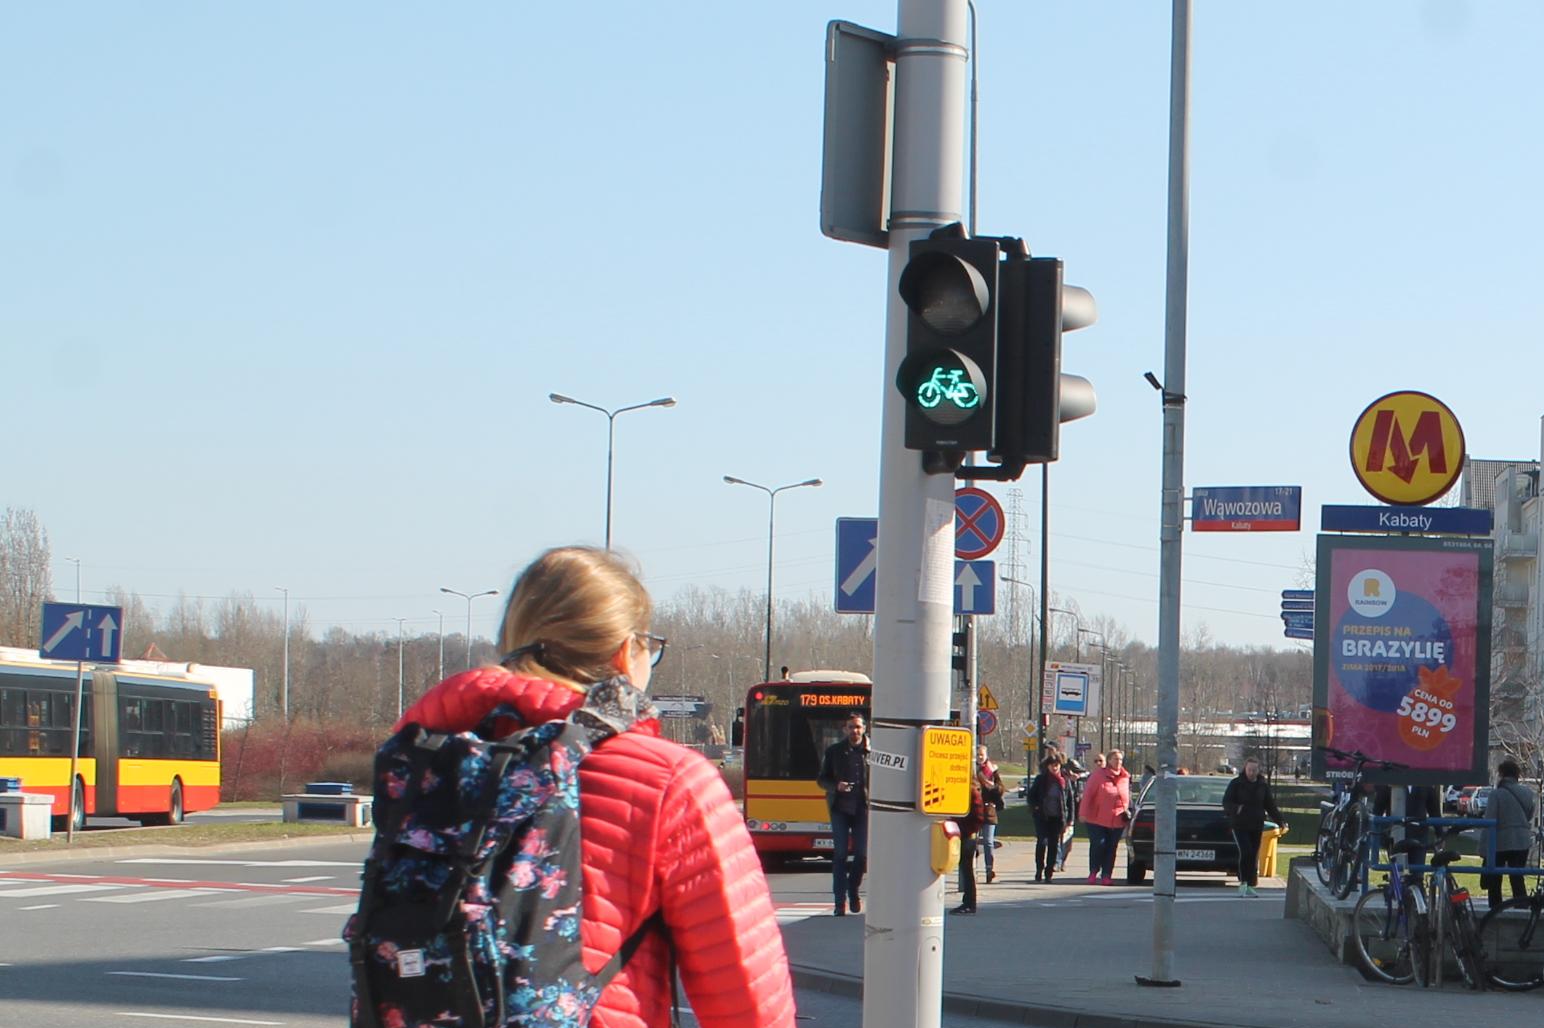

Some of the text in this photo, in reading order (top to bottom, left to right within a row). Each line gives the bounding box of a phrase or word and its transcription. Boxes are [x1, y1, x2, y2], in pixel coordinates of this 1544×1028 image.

[1365, 409, 1447, 485] M
[1203, 498, 1282, 520] Wąwozowa
[1379, 512, 1432, 531] Kabaty
[1343, 625, 1412, 636] PRZEPIS NA
[1342, 639, 1445, 664] BRAZYLIĘ
[800, 694, 817, 706] 179
[1414, 688, 1453, 709] CENA OD
[1396, 695, 1457, 733] 5899
[930, 732, 967, 746] UWAGA!
[1411, 725, 1430, 739] PLN
